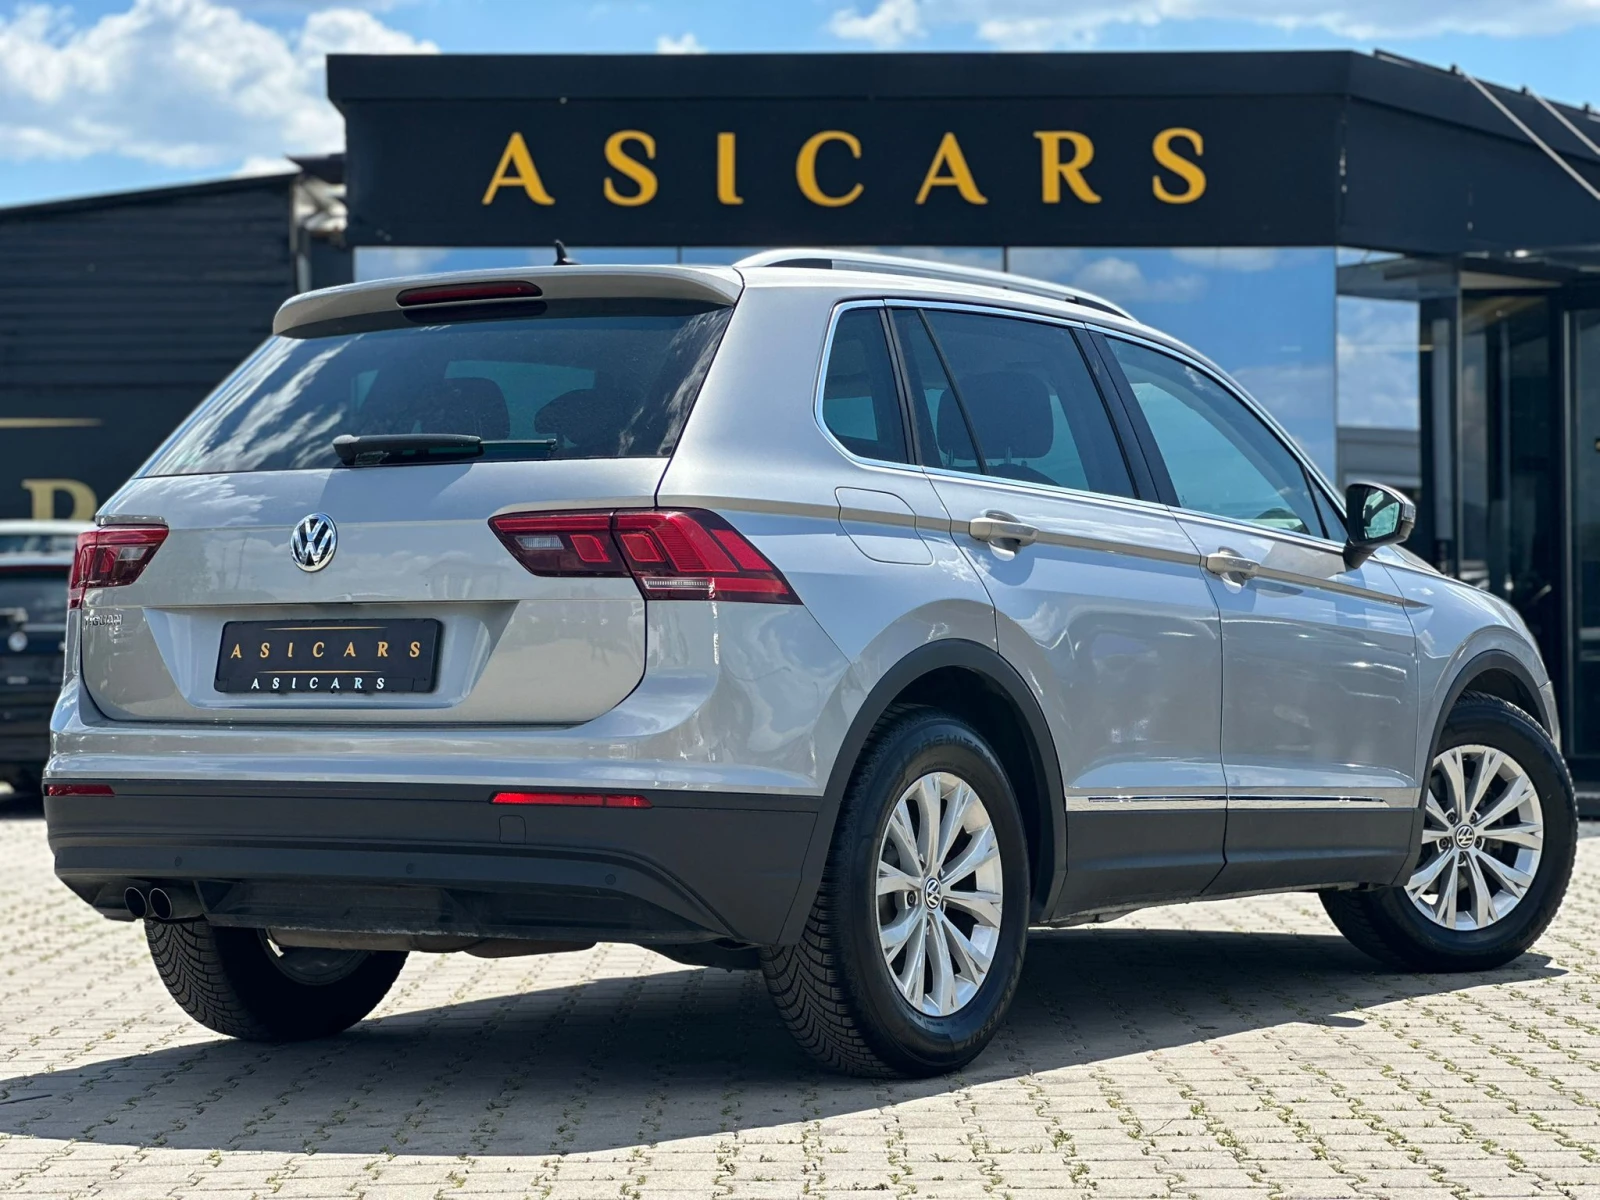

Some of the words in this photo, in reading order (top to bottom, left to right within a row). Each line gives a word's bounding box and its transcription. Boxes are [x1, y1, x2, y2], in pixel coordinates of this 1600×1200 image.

[483, 127, 1207, 207] ASICARS
[290, 512, 338, 572] VW
[230, 641, 421, 659] ASICARS
[250, 676, 386, 690] ASICARS
